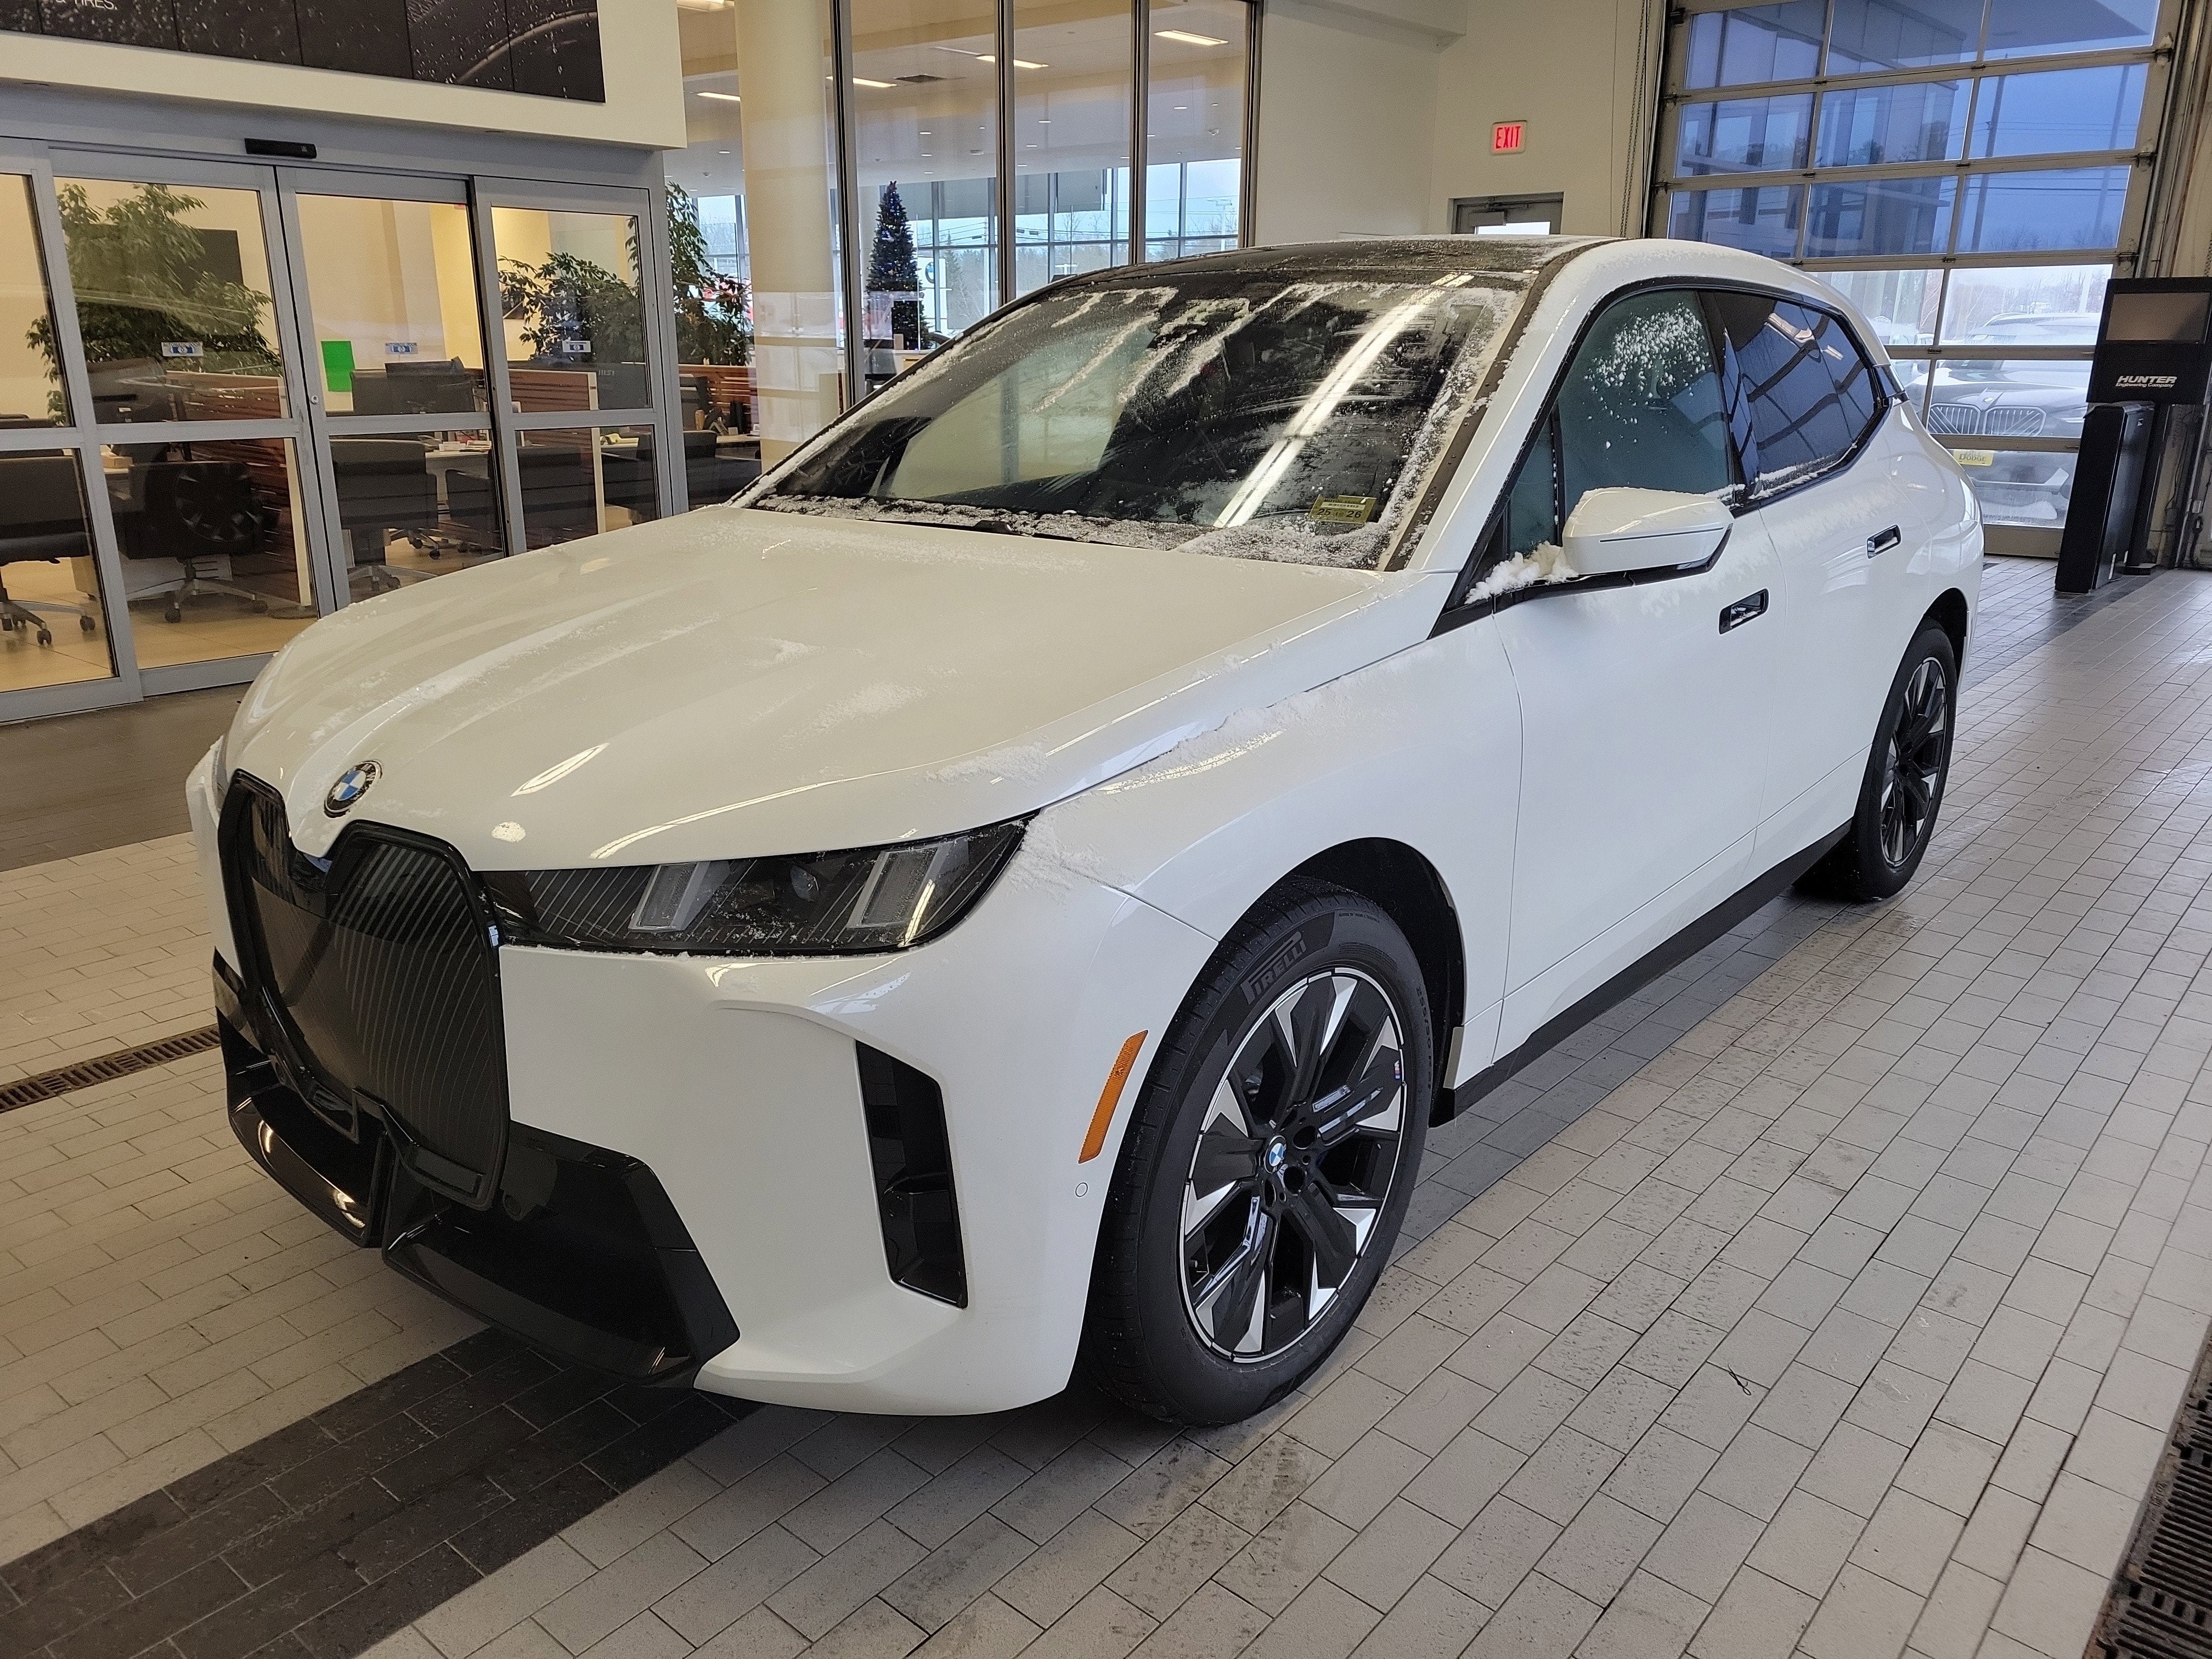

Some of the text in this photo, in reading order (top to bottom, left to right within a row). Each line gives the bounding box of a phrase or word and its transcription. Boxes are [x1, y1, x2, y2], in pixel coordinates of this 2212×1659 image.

[1496, 126, 1521, 149] EXIT
[2117, 375, 2177, 383] HUNTER
[1317, 508, 1332, 516] 25
[1240, 931, 1306, 1005] PIRELLI
